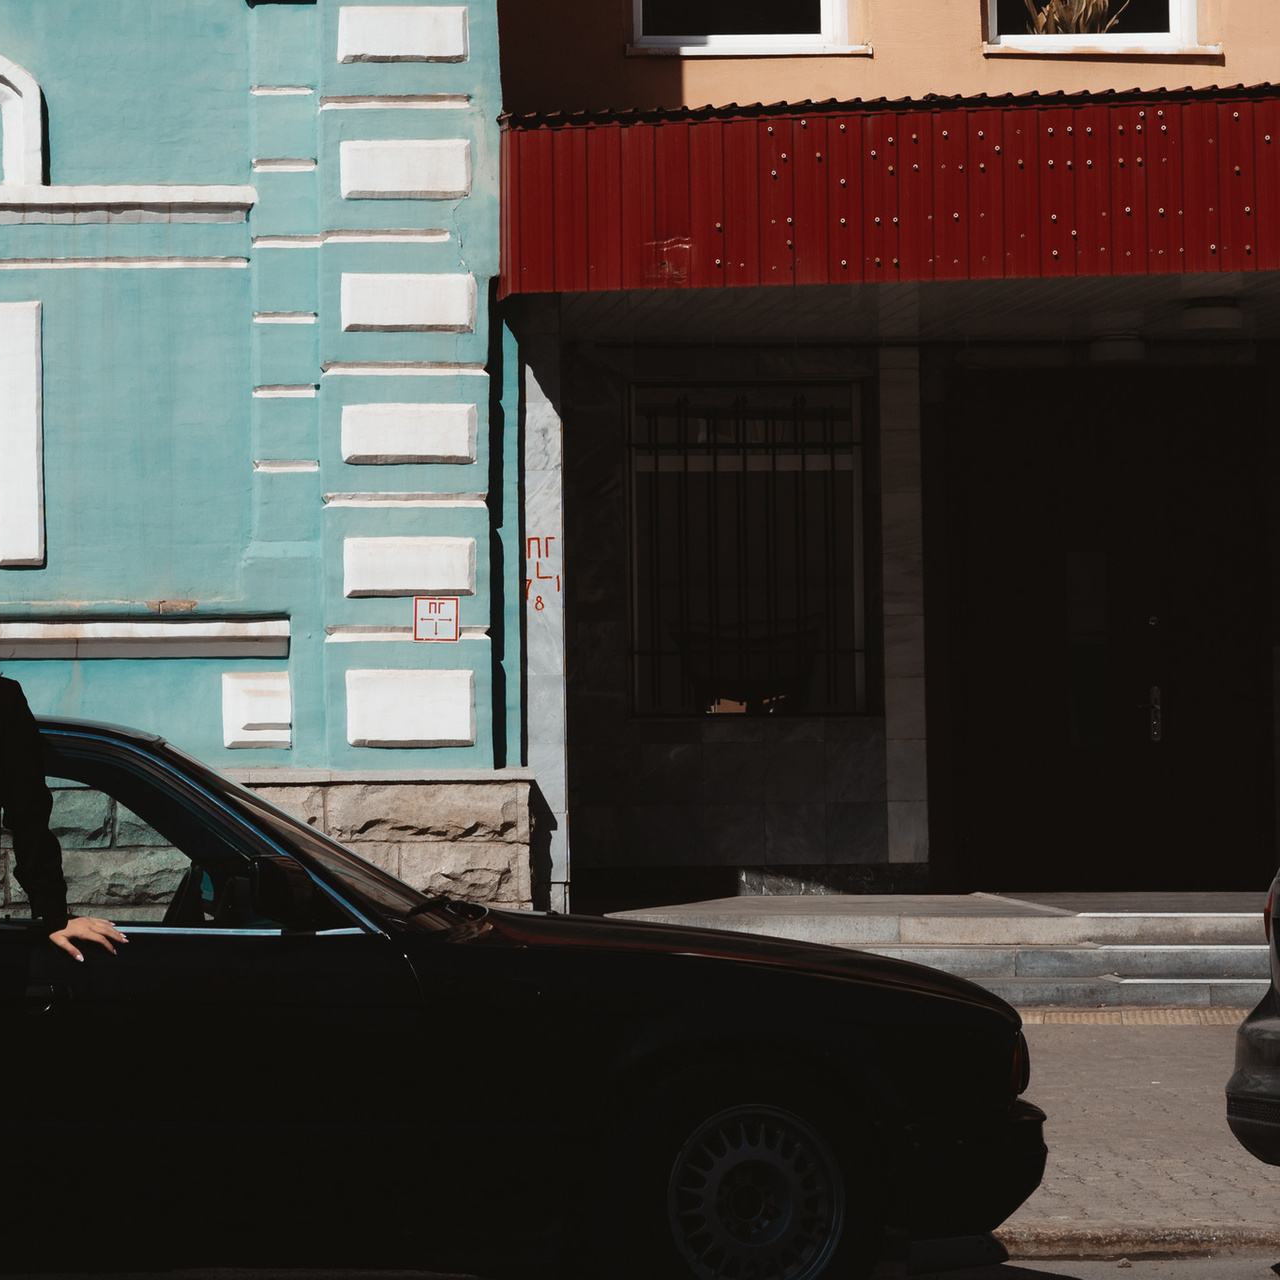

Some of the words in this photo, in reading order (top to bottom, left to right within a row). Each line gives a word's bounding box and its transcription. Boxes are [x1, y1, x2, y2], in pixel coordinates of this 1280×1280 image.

[527, 536, 555, 559] ПГ
[428, 602, 445, 614] ПГ
[534, 595, 545, 611] 8
